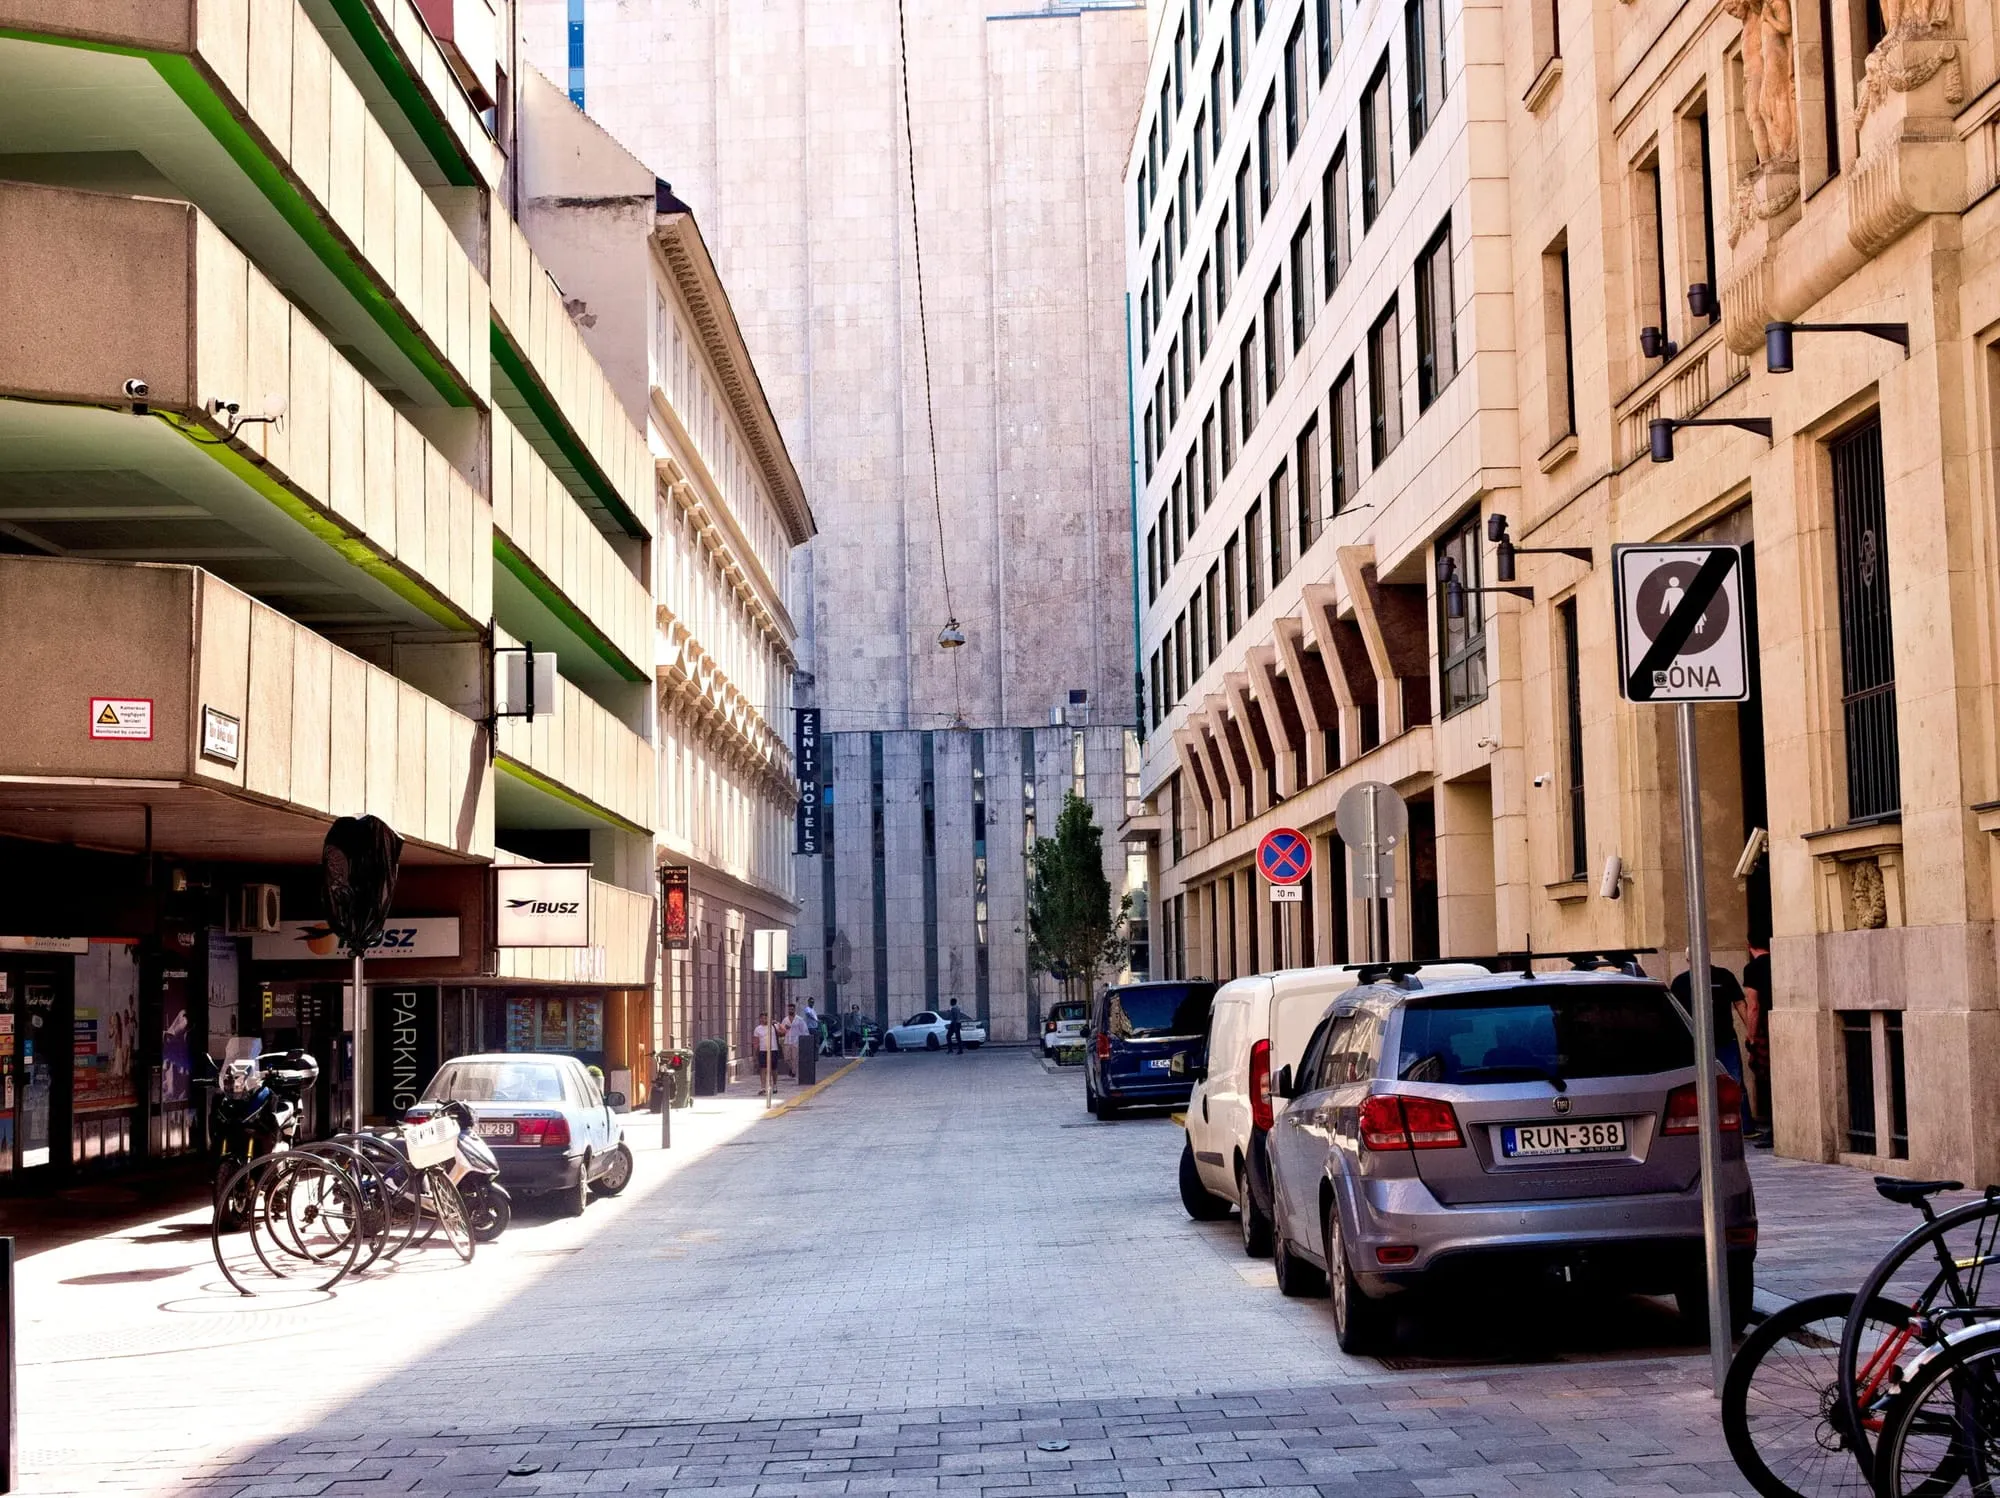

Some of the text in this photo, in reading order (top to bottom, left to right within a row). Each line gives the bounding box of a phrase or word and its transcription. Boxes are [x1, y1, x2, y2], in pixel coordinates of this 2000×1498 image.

[1654, 660, 1721, 688] ÓNA
[803, 713, 816, 852] ZENIT HOTELS
[530, 902, 580, 914] IBUSZ
[393, 992, 417, 1111] PARKING
[478, 1123, 512, 1134] N-283
[1521, 1124, 1619, 1149] RUN-368
